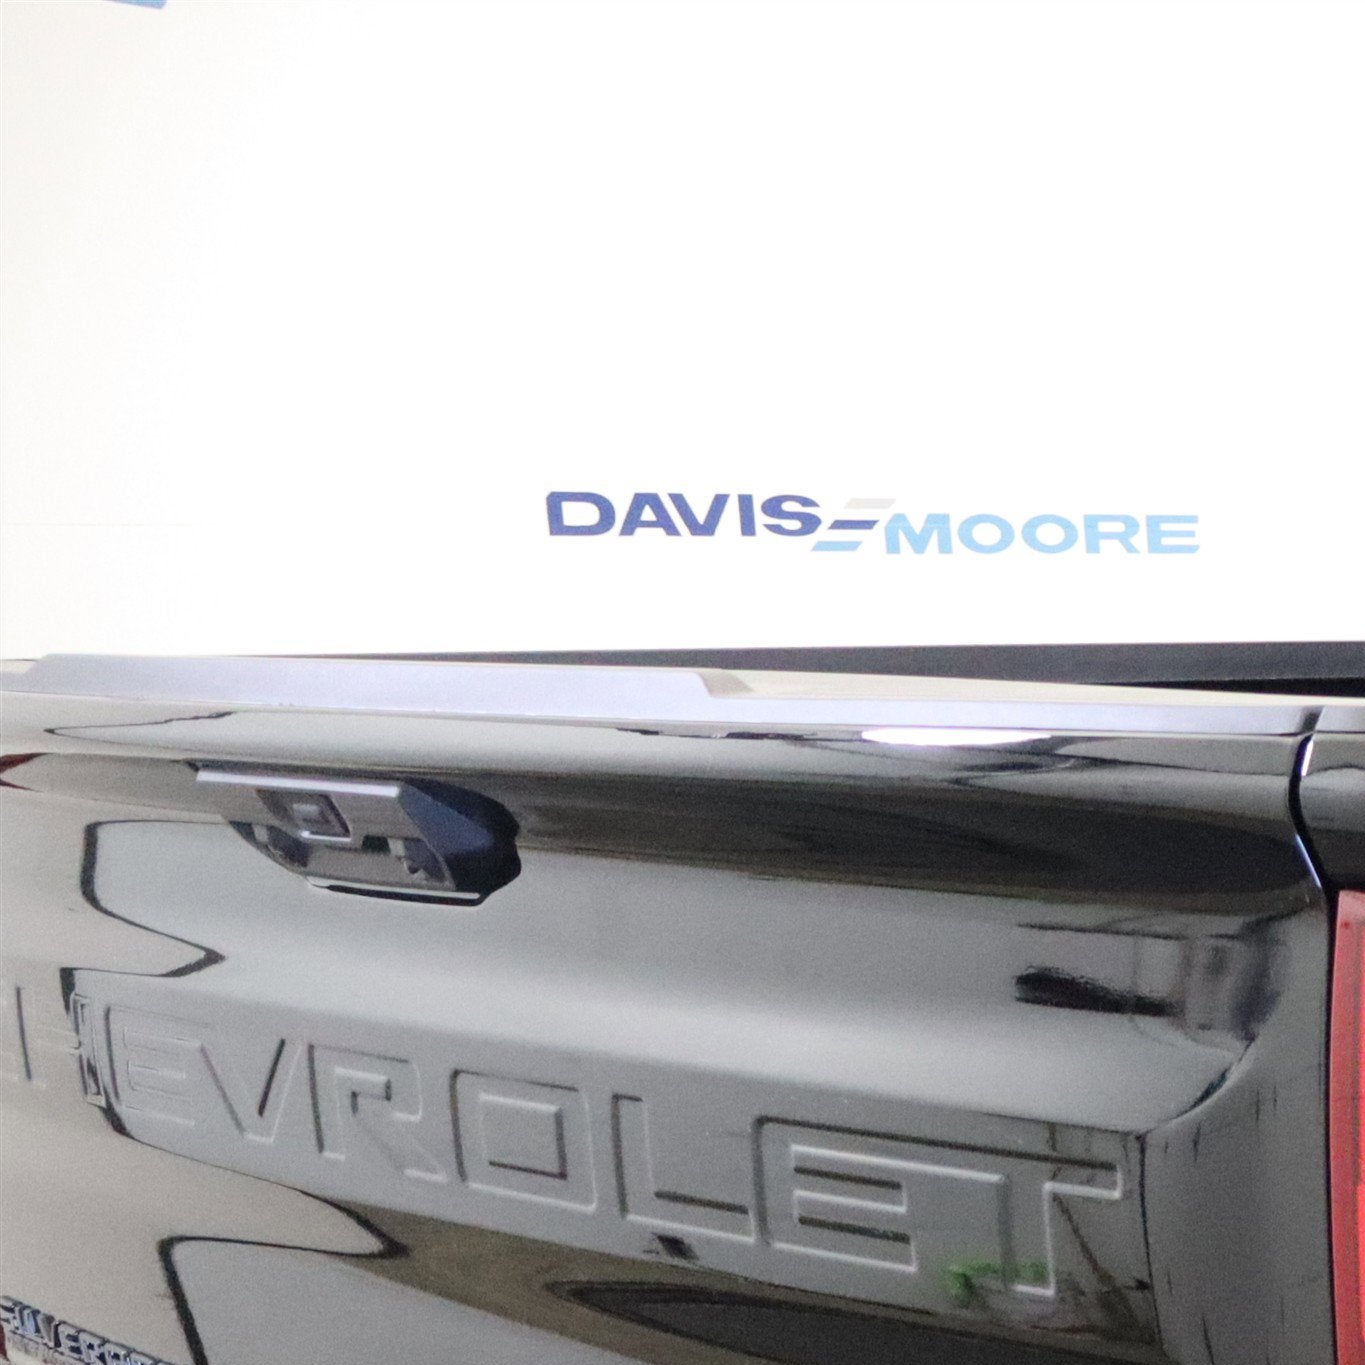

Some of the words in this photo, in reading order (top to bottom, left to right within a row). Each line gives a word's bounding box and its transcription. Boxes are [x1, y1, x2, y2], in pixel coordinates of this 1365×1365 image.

[545, 490, 823, 538] DAVIS
[884, 512, 1200, 555] MOORE
[0, 983, 1123, 1296] HEVROLET
